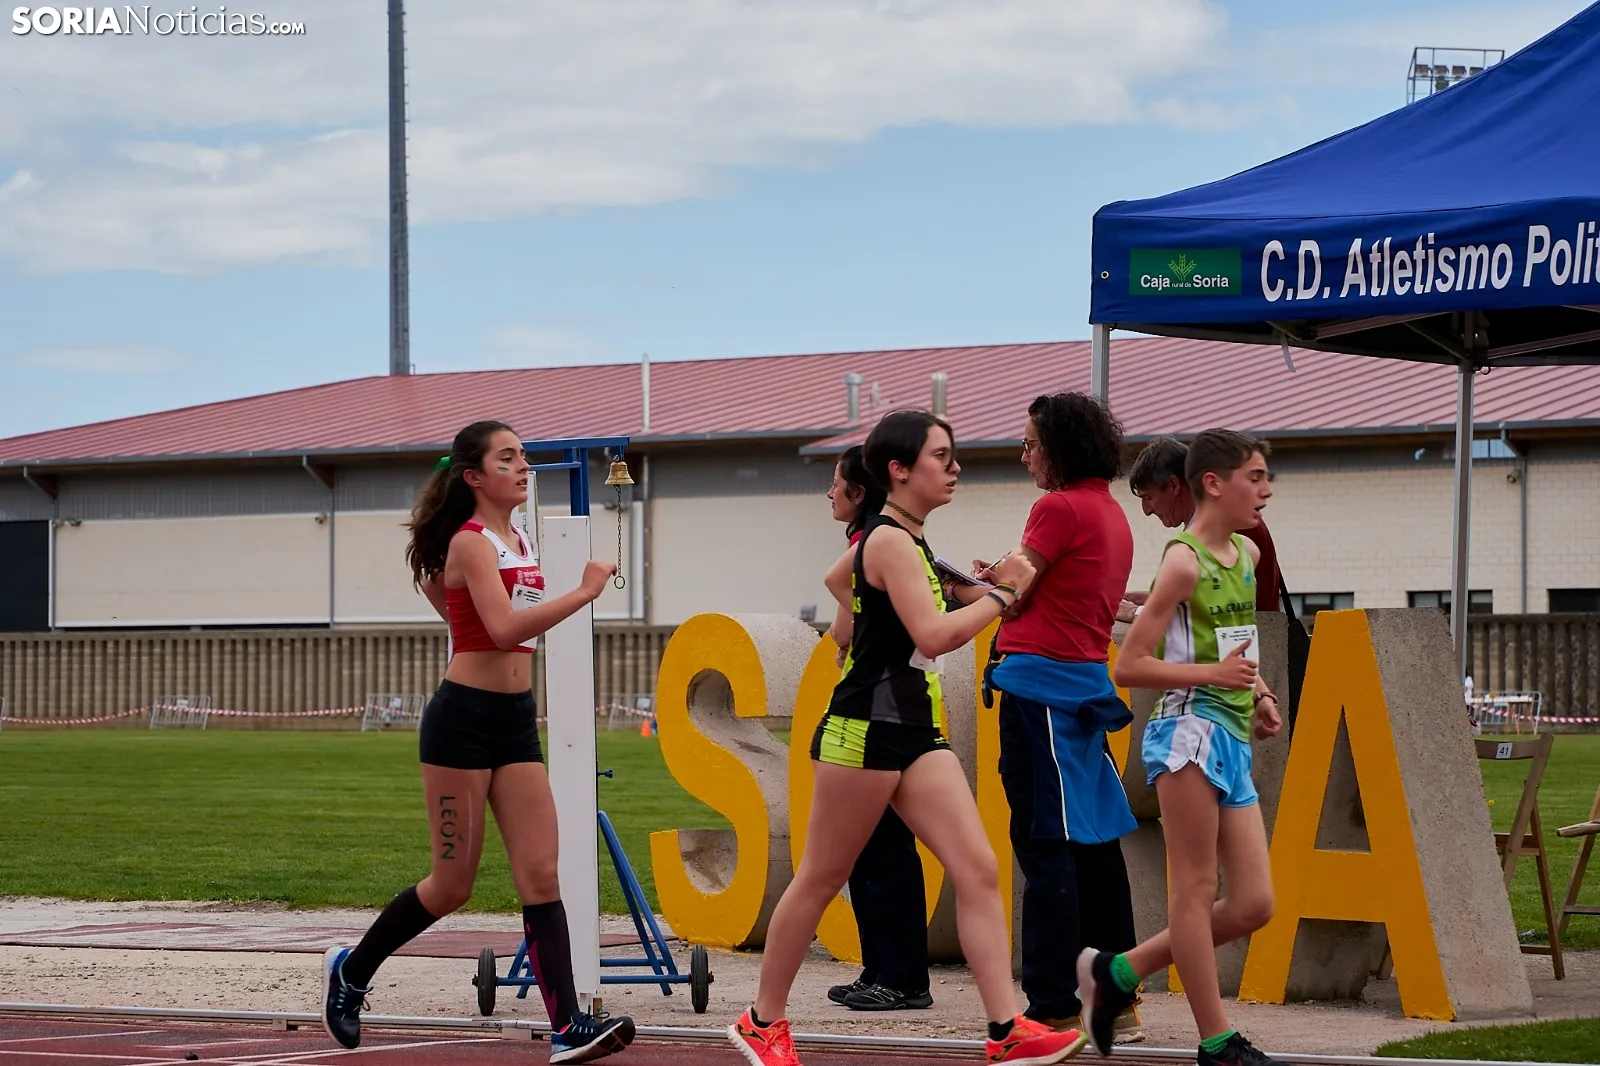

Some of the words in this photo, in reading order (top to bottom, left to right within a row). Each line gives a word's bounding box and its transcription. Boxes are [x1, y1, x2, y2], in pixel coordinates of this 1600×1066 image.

[1141, 274, 1171, 291] Caja
[1193, 274, 1229, 288] Soria
[1261, 240, 1331, 302] C.D.
[1340, 232, 1513, 299] Atletismo
[1499, 746, 1509, 756] 41
[440, 795, 464, 860] LEÓN
